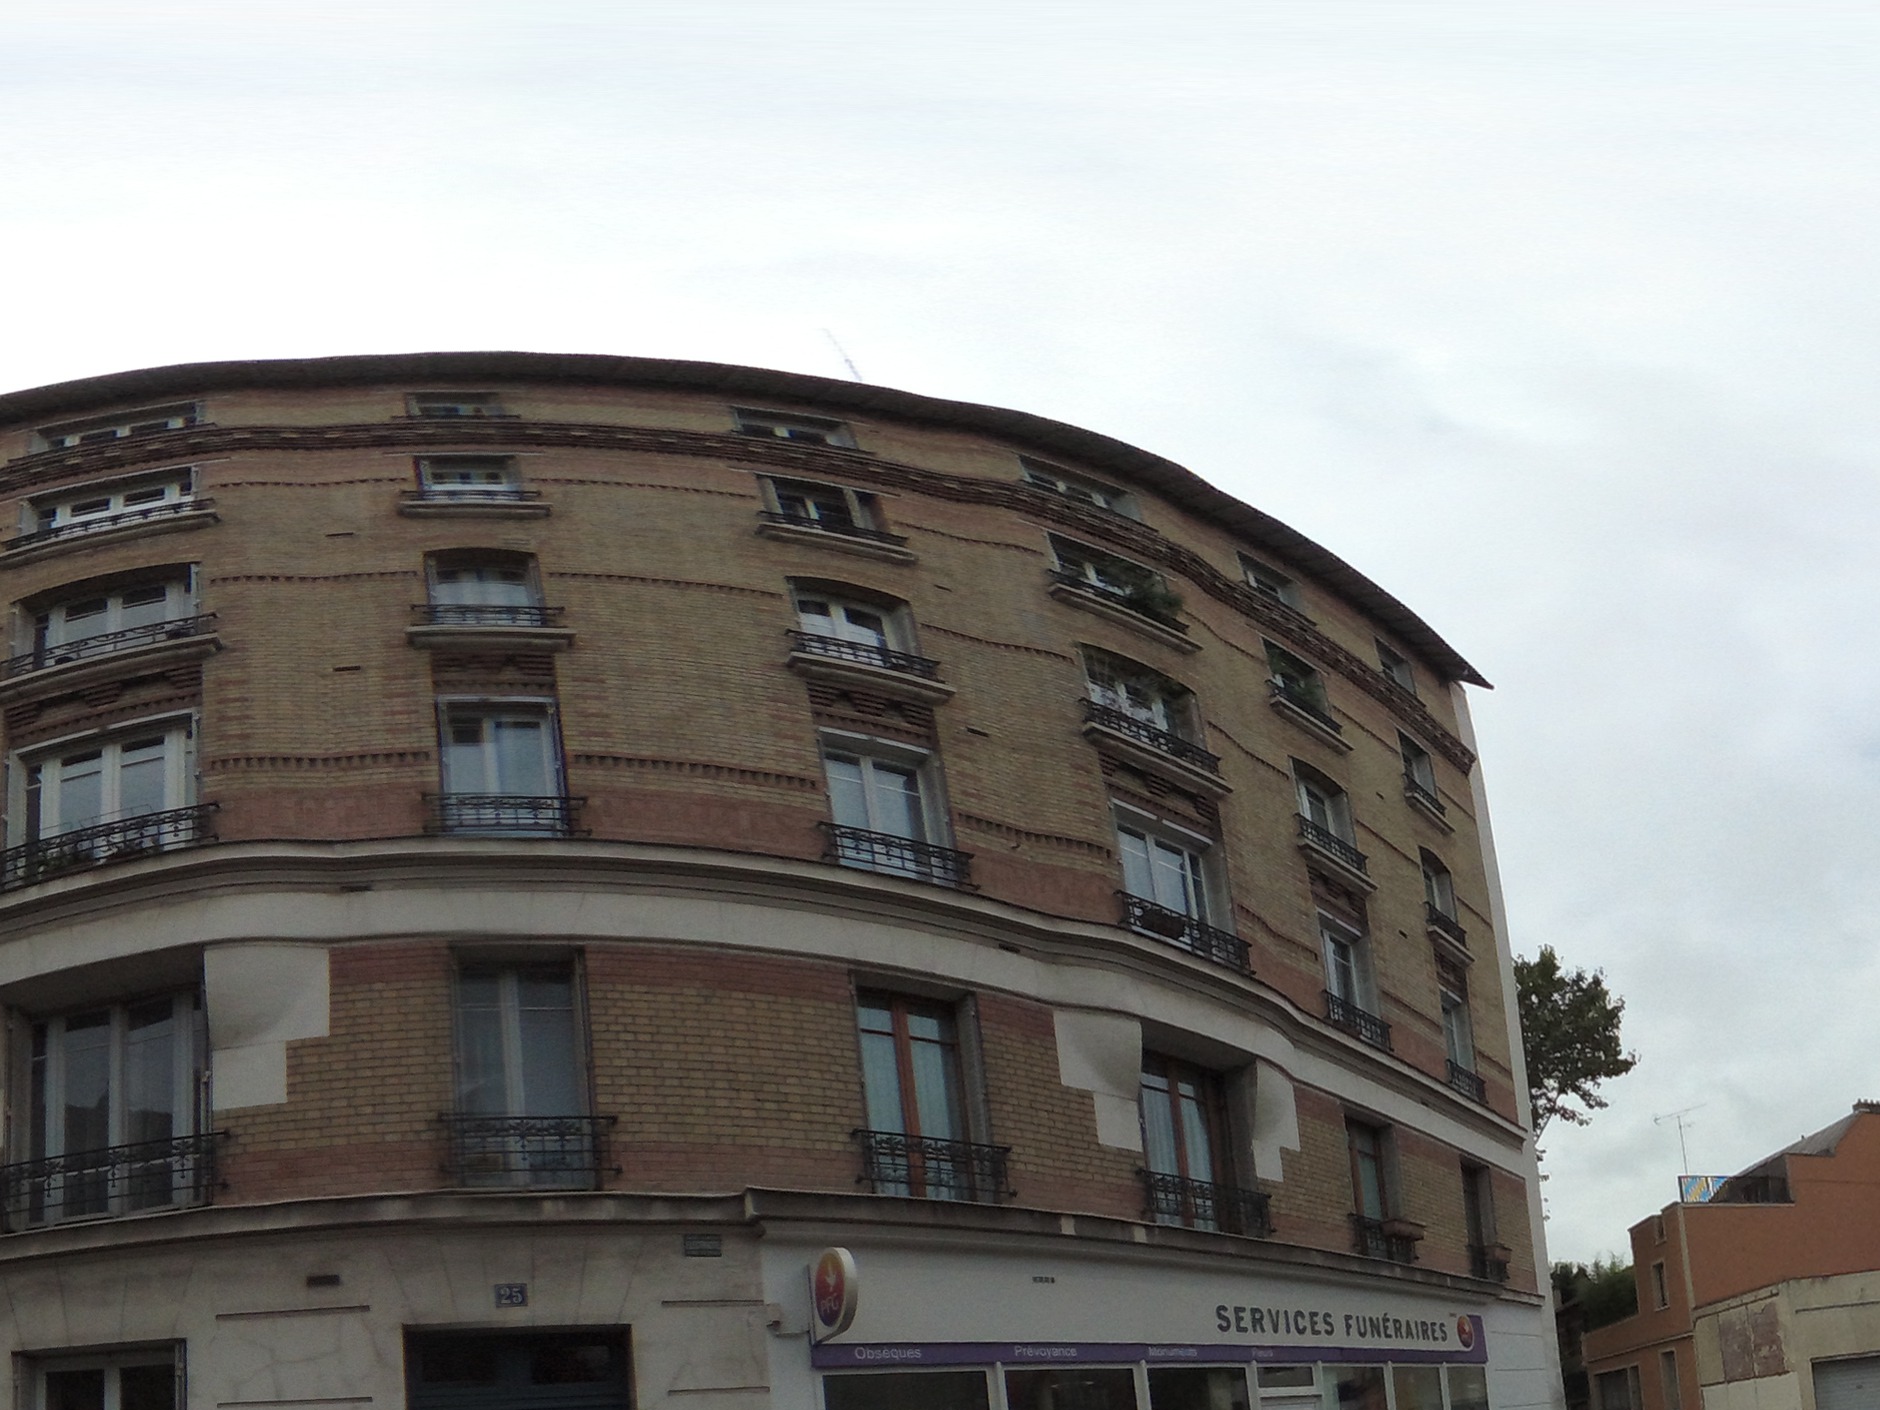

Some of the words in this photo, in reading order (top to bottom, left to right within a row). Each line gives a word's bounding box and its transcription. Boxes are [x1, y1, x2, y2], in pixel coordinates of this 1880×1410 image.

[500, 1287, 523, 1304] 25
[1215, 1304, 1335, 1337] SERVICES
[1343, 1312, 1449, 1342] FUNÉRAIRES
[854, 1346, 922, 1360] Obsèques
[1014, 1344, 1077, 1359] Prévoyance
